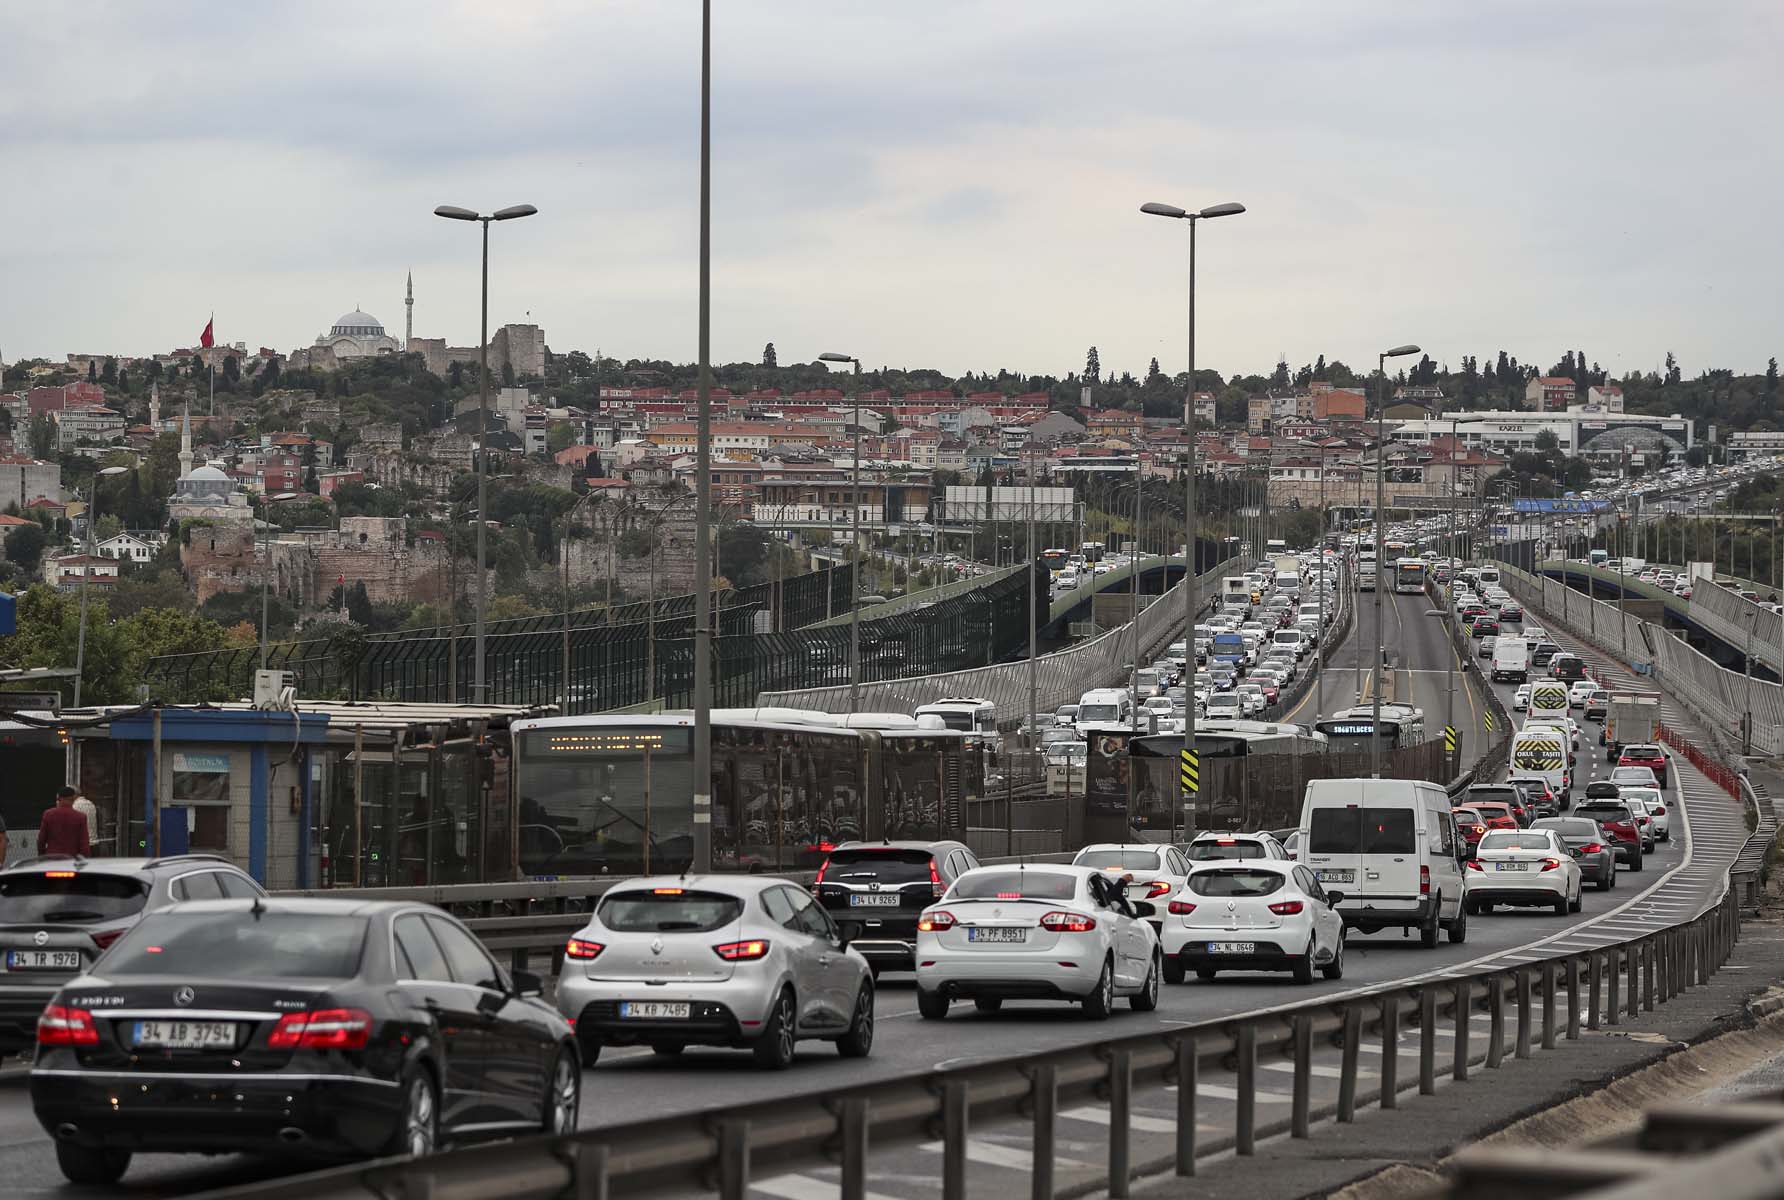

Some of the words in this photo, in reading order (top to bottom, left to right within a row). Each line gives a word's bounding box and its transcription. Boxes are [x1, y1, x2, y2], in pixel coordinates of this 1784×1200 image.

[856, 896, 864, 905] 34
[868, 896, 877, 905] LV
[879, 896, 897, 905] 9265
[975, 929, 985, 938] 34
[989, 929, 999, 938] PF
[15, 952, 26, 965] 34
[35, 952, 48, 965] TR
[53, 952, 78, 965] 1978
[628, 1003, 639, 1016] 34
[645, 1003, 657, 1016] KB
[663, 1003, 688, 1016] 7485
[143, 1022, 161, 1040] 34
[167, 1022, 188, 1040] AB
[192, 1022, 232, 1040] 3794
